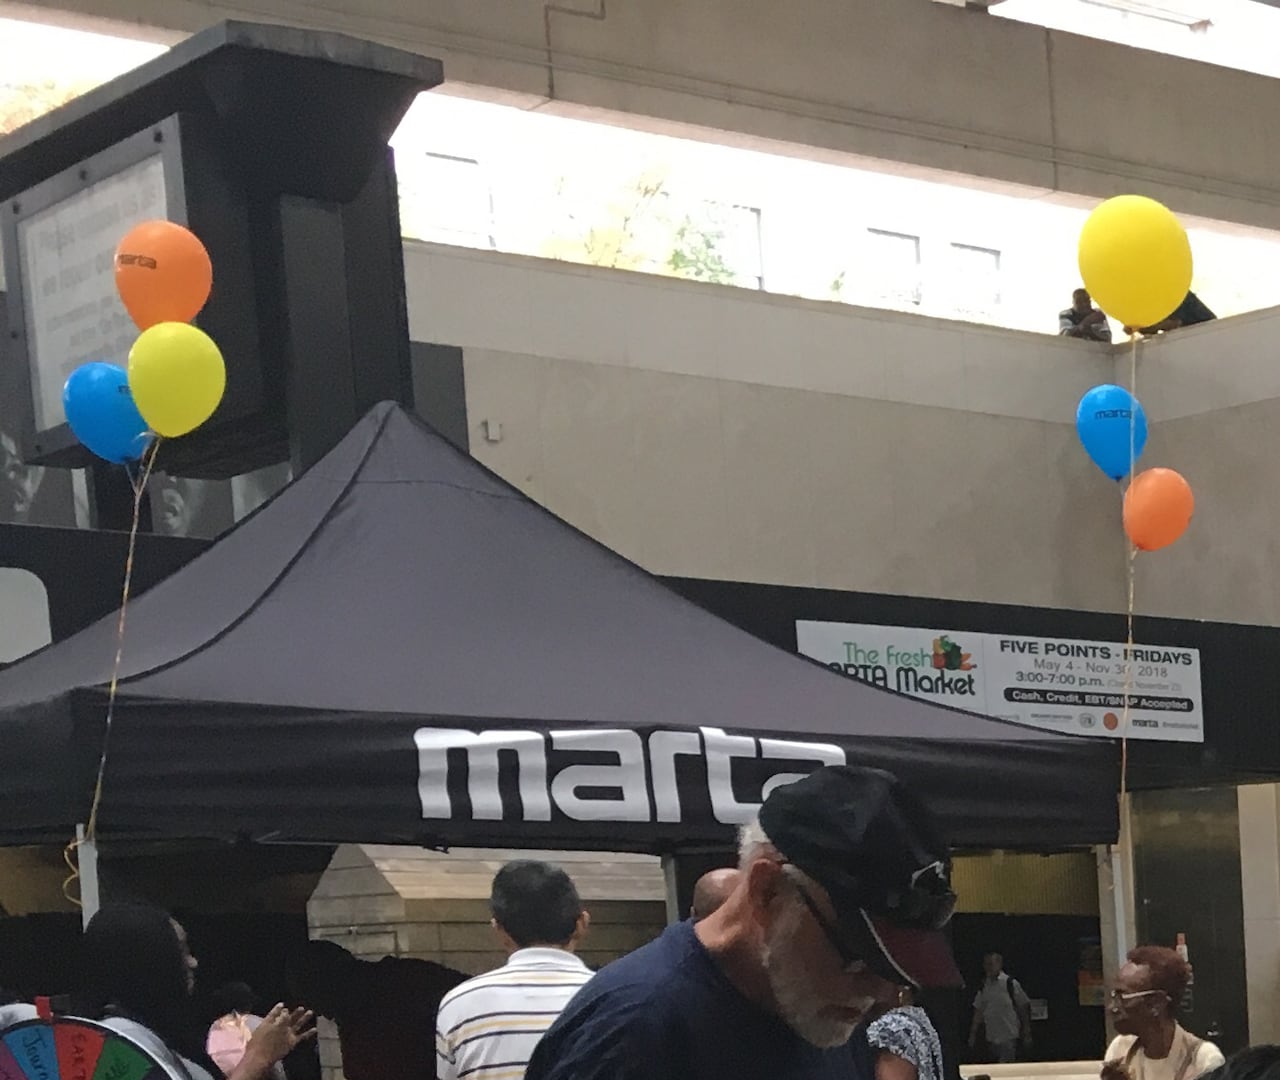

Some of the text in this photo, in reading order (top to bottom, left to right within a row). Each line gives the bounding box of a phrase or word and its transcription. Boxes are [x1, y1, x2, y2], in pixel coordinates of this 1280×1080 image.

[843, 641, 933, 668] The Fresh
[1000, 639, 1039, 655] FIVE
[1044, 643, 1111, 660] POINTS
[1124, 648, 1193, 666] FRIDAYS
[1016, 671, 1076, 685] 3:00-7:00
[1078, 675, 1105, 687] p.m.
[1034, 657, 1060, 673] May
[1066, 661, 1074, 671] 4
[1086, 661, 1110, 674] Nov
[1138, 665, 1168, 679] 2018
[896, 666, 976, 696] Market
[1012, 690, 1044, 702] Cash,
[1046, 692, 1083, 705] Credit,
[1141, 697, 1188, 711] Accepted
